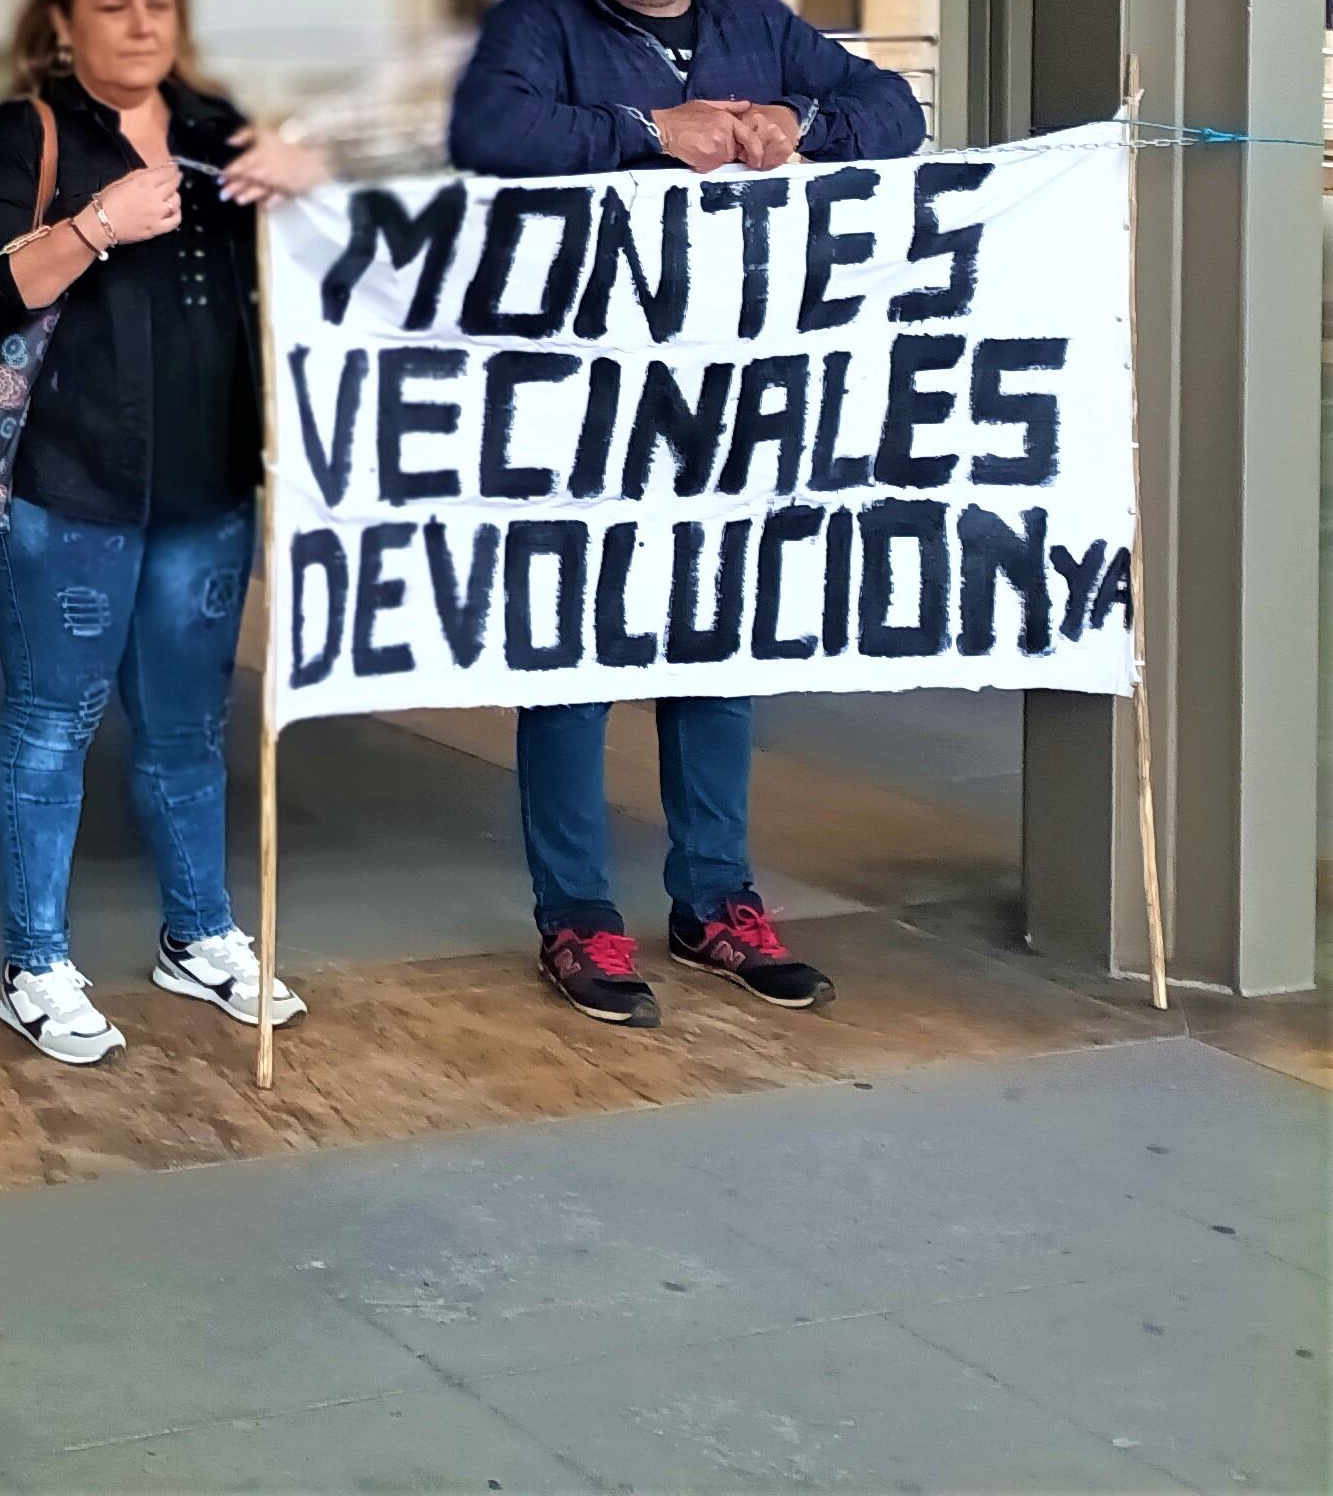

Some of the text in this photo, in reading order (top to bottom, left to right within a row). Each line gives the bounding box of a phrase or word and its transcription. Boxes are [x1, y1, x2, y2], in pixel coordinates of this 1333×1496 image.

[321, 162, 995, 342] MONTES
[289, 333, 1071, 504] VECINALES
[291, 499, 1133, 688] DEVOLUCION YA
